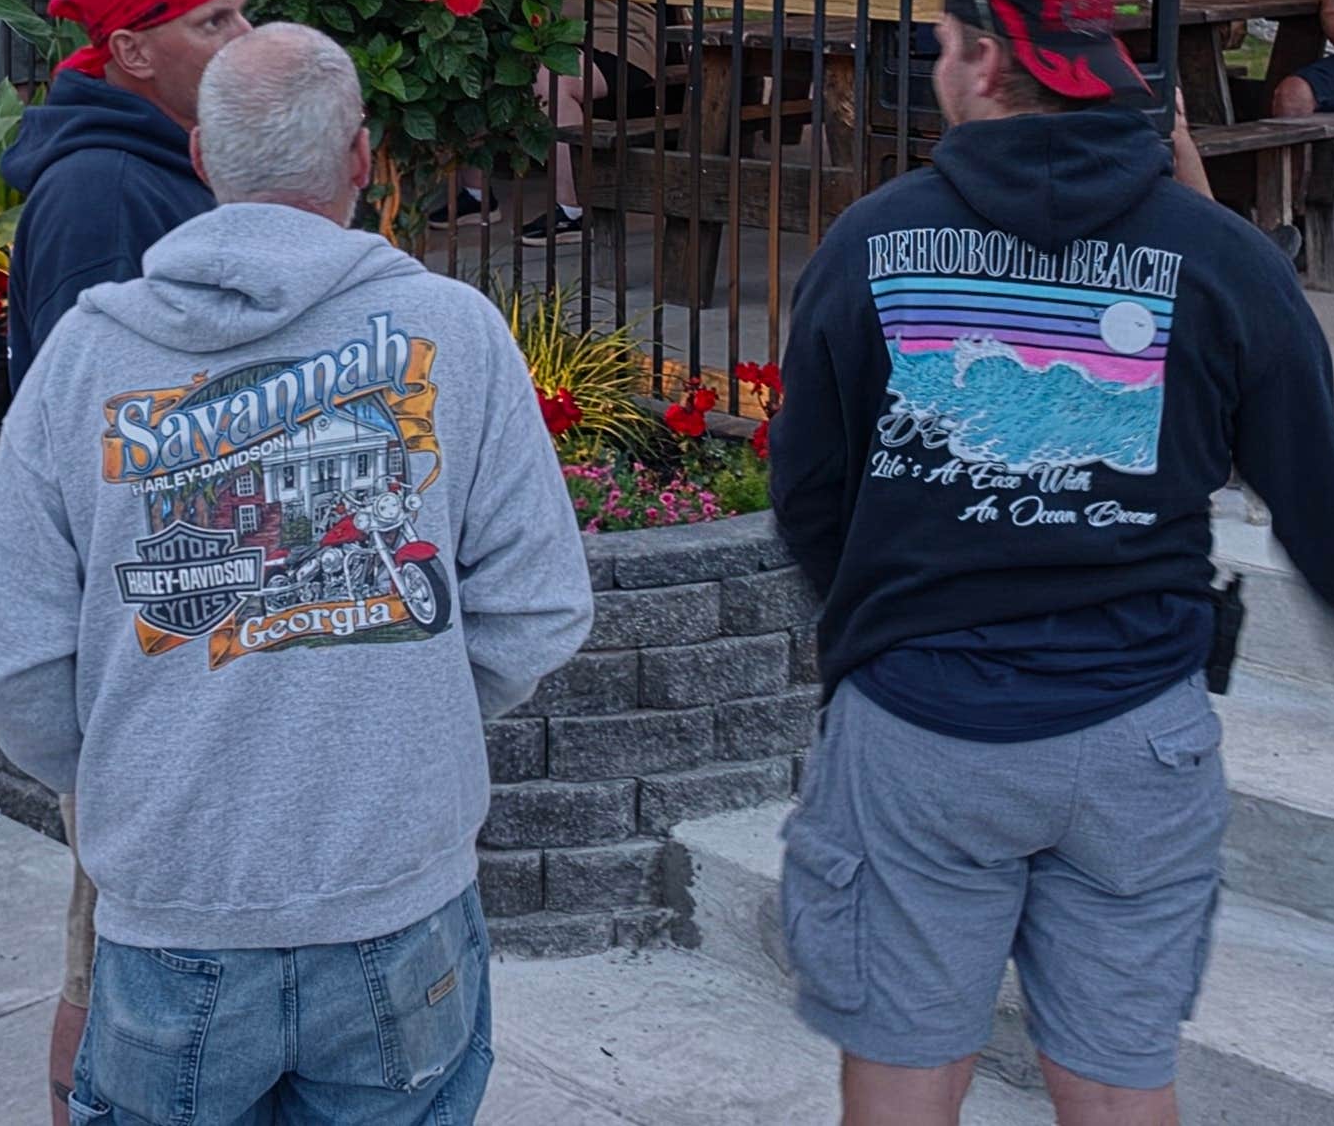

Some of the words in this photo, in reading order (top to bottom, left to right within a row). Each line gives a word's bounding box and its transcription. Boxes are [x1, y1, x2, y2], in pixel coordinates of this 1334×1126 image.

[1061, 239, 1183, 299] BEACH
[116, 312, 410, 474] Savannah
[131, 437, 286, 496] HARLEY-DAVIDSON
[870, 450, 922, 479] Life's
[924, 457, 966, 485] At
[967, 460, 1021, 490] Ease
[1028, 463, 1094, 493] With
[957, 495, 1000, 523] An
[1009, 495, 1078, 526] Ocean
[1084, 500, 1157, 527] Breeze
[148, 534, 220, 562] MOTOR
[126, 558, 256, 596] HARLEY-DAVIDSON
[151, 593, 226, 628] CYCLES
[239, 600, 392, 650] Georgia
